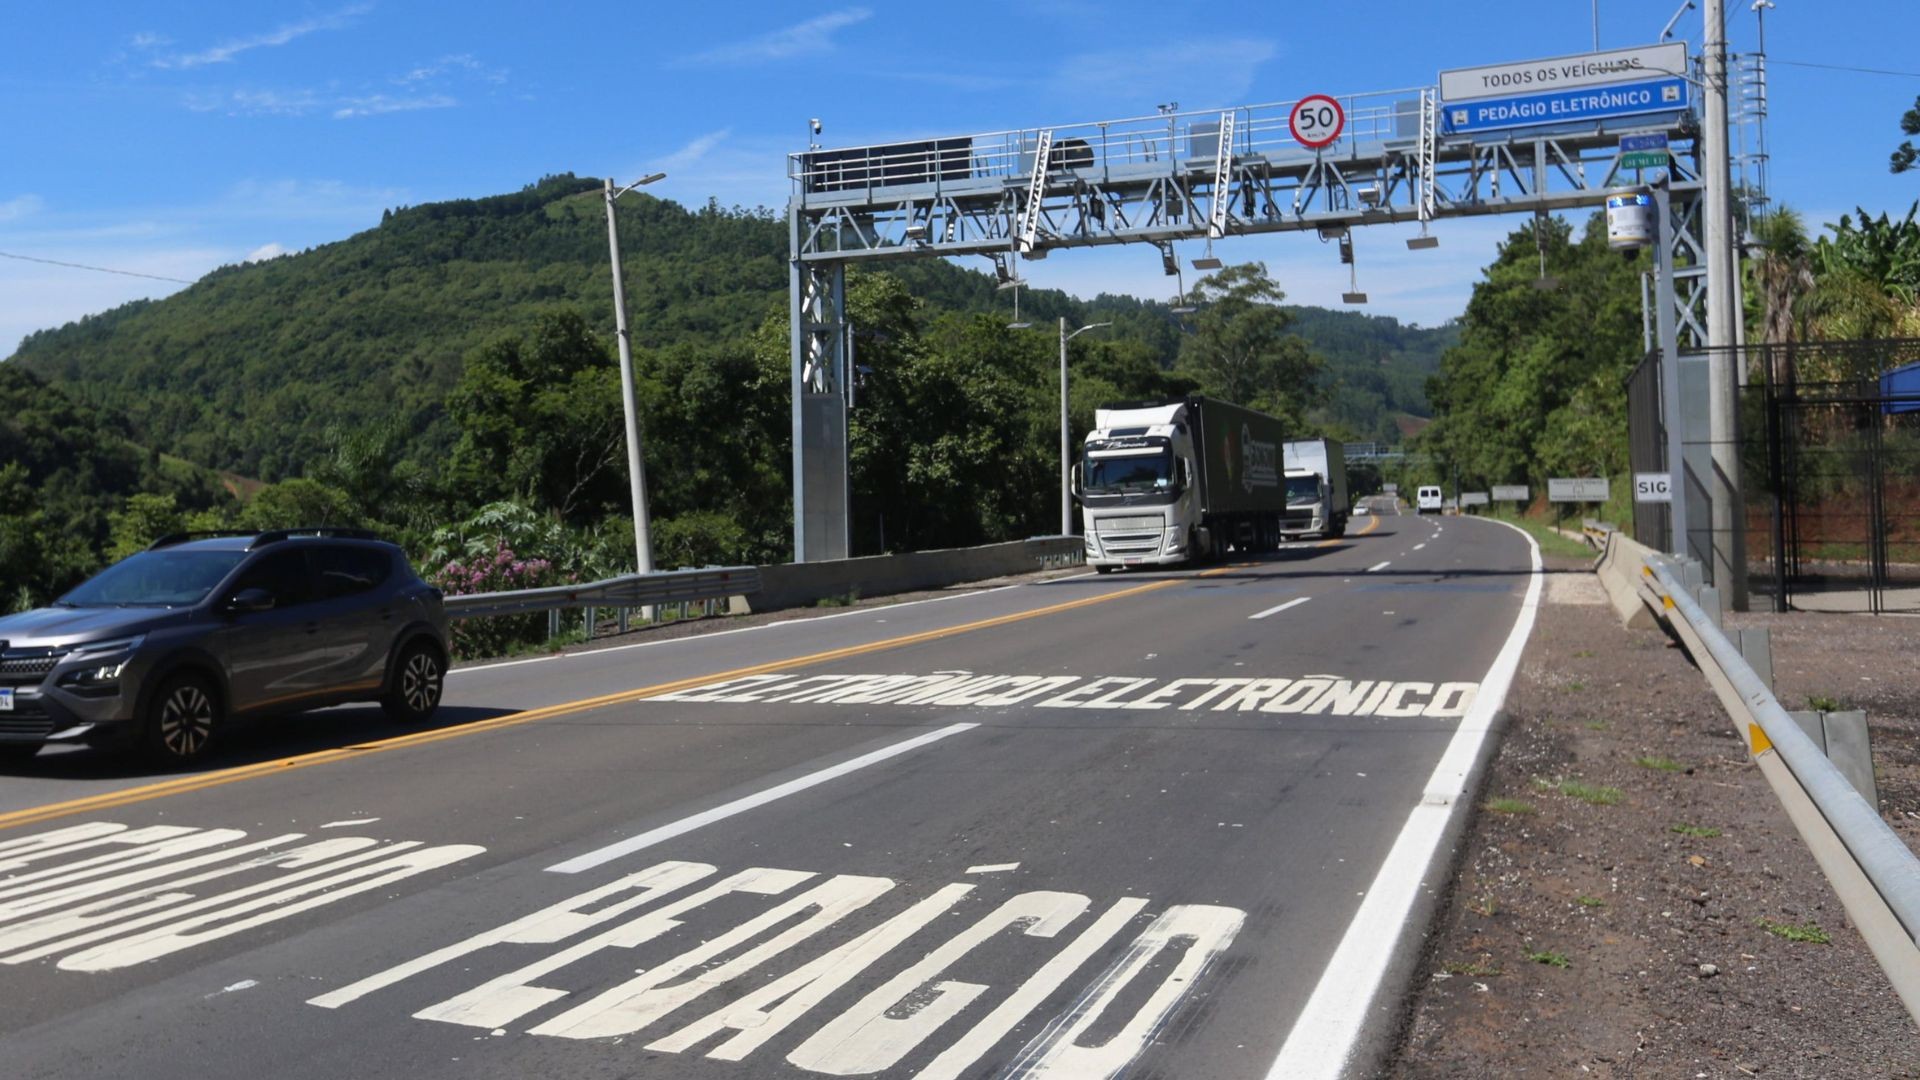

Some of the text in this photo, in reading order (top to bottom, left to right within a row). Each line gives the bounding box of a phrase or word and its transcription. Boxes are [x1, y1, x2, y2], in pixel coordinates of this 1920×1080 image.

[1481, 70, 1533, 88] TODOS
[1537, 69, 1557, 82] OS
[1300, 106, 1334, 130] 50
[1478, 90, 1650, 122] PEDÁGIO ELETRÔNICO
[1638, 481, 1672, 494] SIG
[640, 669, 1082, 706] ELETRÔNICO
[1033, 674, 1480, 717] ELETRÔNICO
[305, 860, 1247, 1080] PEDÁGIO
